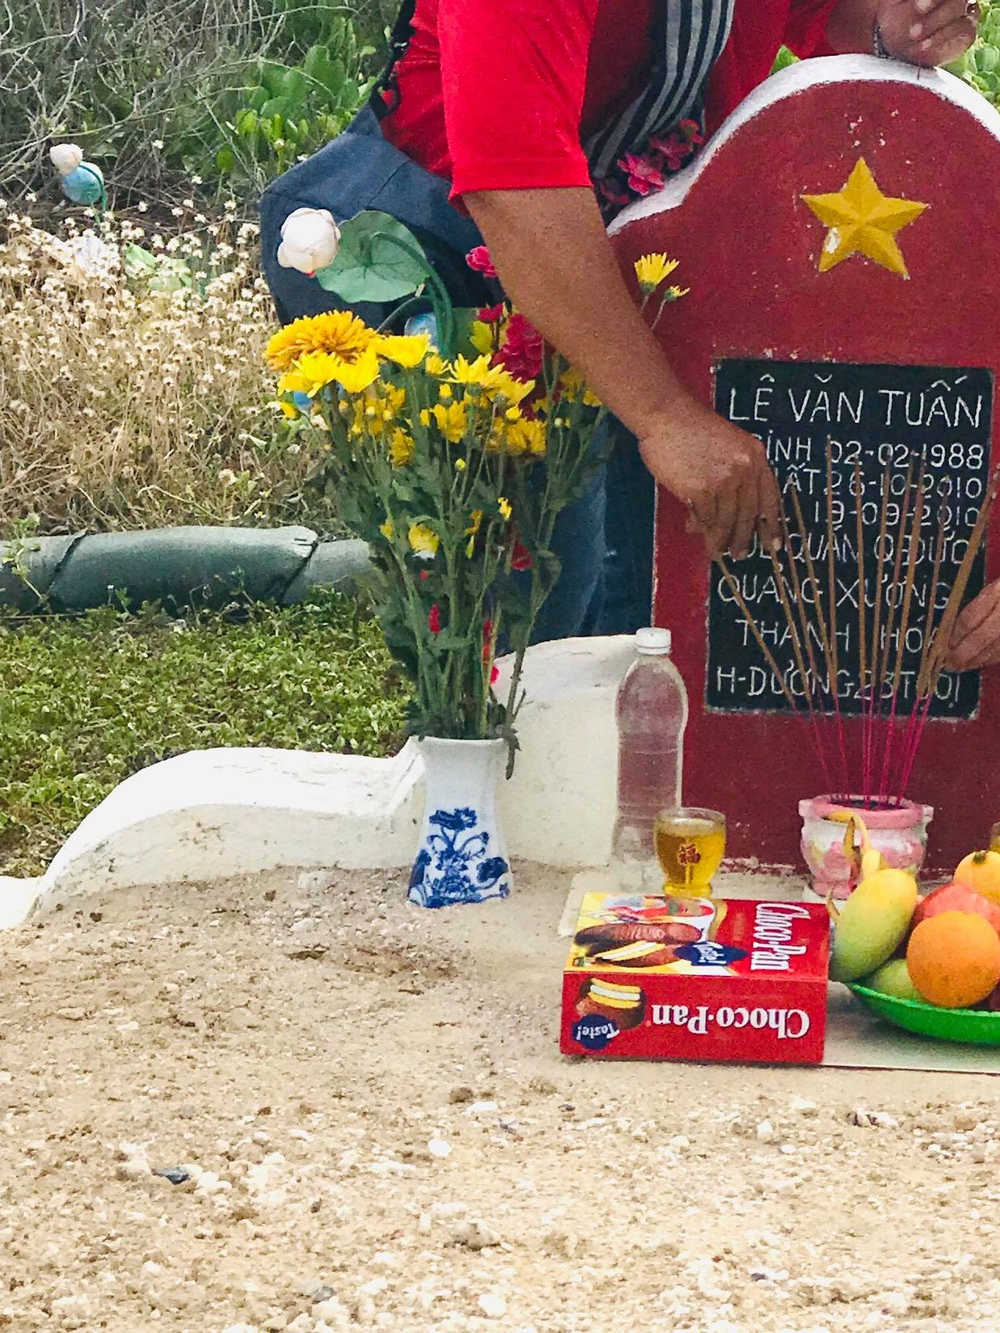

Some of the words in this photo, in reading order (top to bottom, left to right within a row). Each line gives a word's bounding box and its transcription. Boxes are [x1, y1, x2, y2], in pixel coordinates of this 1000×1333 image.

[729, 373, 775, 422] LÊ
[788, 373, 864, 424] VĂN
[878, 375, 983, 428] TUẤN
[752, 429, 812, 462] INH
[826, 439, 984, 470] 02-02-1988
[774, 462, 821, 495] ẤT
[823, 470, 983, 499] 26-10-2010
[734, 618, 850, 653] THANH
[575, 1022, 621, 1042] Taste!
